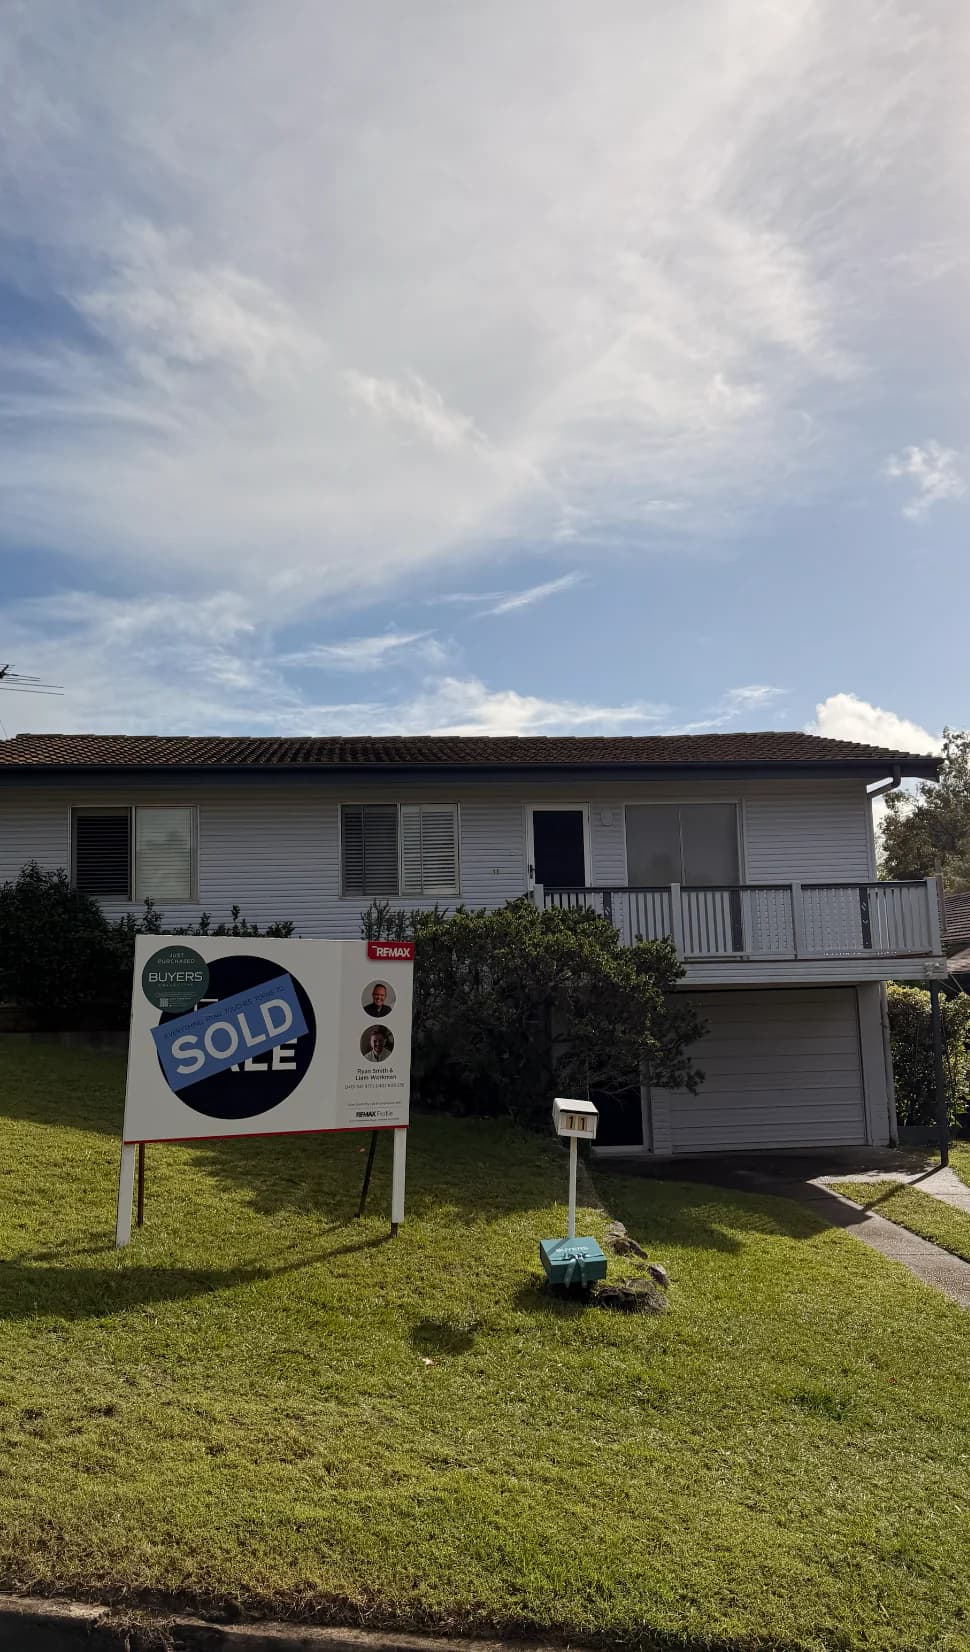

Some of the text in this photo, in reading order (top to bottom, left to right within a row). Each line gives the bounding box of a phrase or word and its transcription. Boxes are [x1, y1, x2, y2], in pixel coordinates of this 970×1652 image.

[148, 971, 203, 982] BUYERS
[171, 998, 293, 1074] SOLD
[569, 1115, 585, 1130] 11
